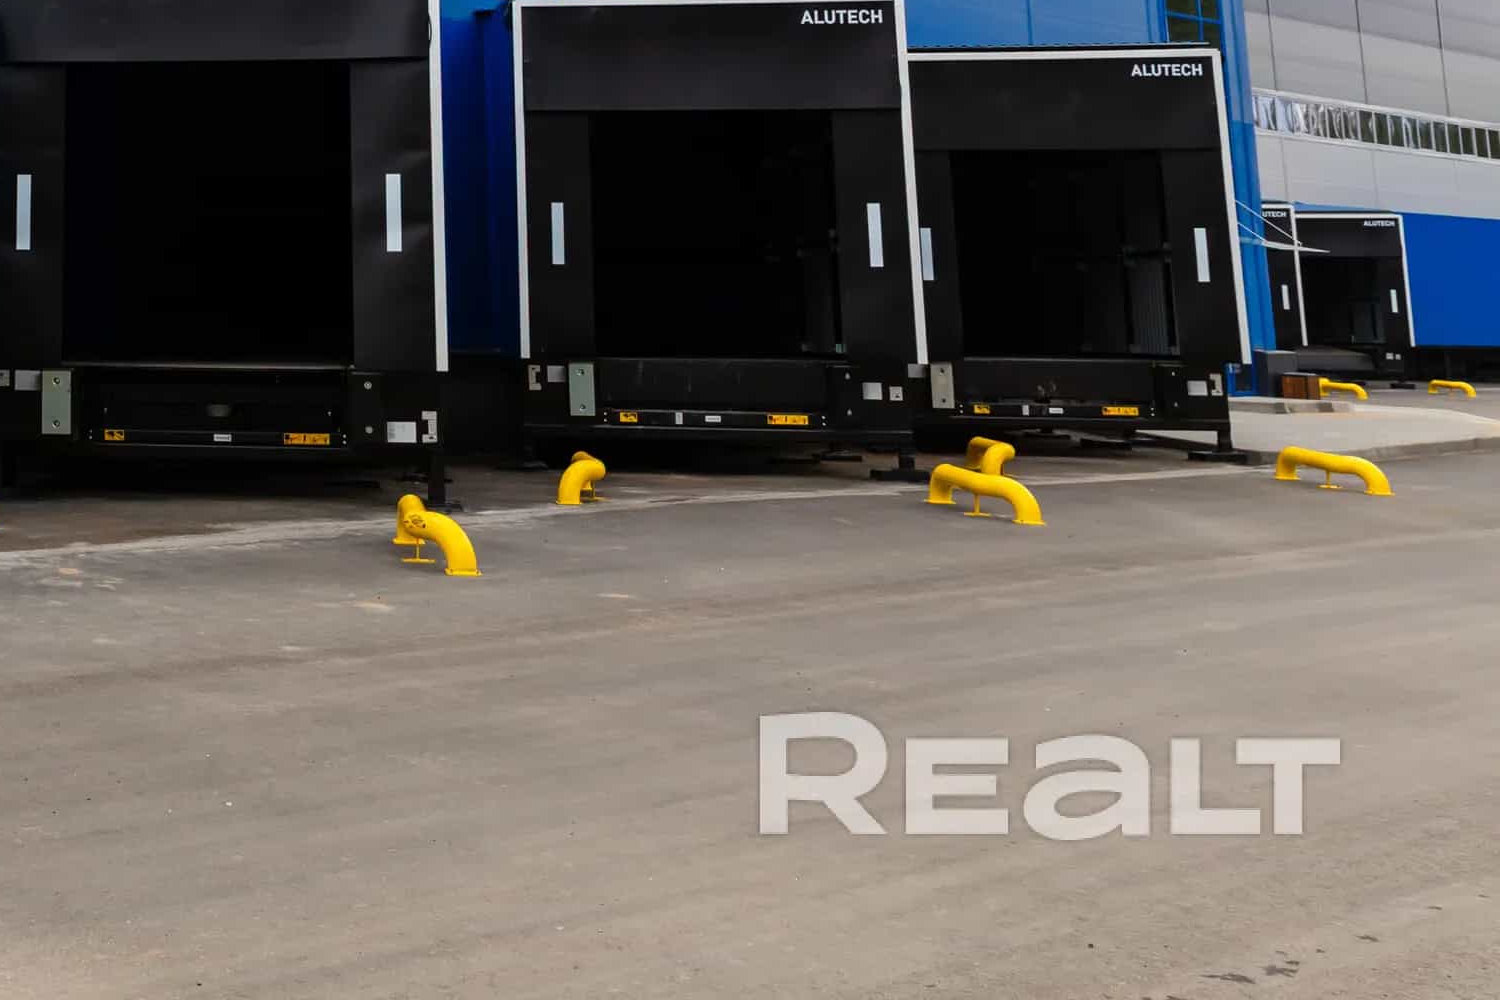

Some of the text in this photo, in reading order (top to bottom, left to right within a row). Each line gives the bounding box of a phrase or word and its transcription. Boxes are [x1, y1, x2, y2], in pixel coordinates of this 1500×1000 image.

[800, 9, 883, 25] ALUTECH
[1131, 63, 1203, 77] ALUTECH
[1363, 219, 1396, 227] ALUTECH
